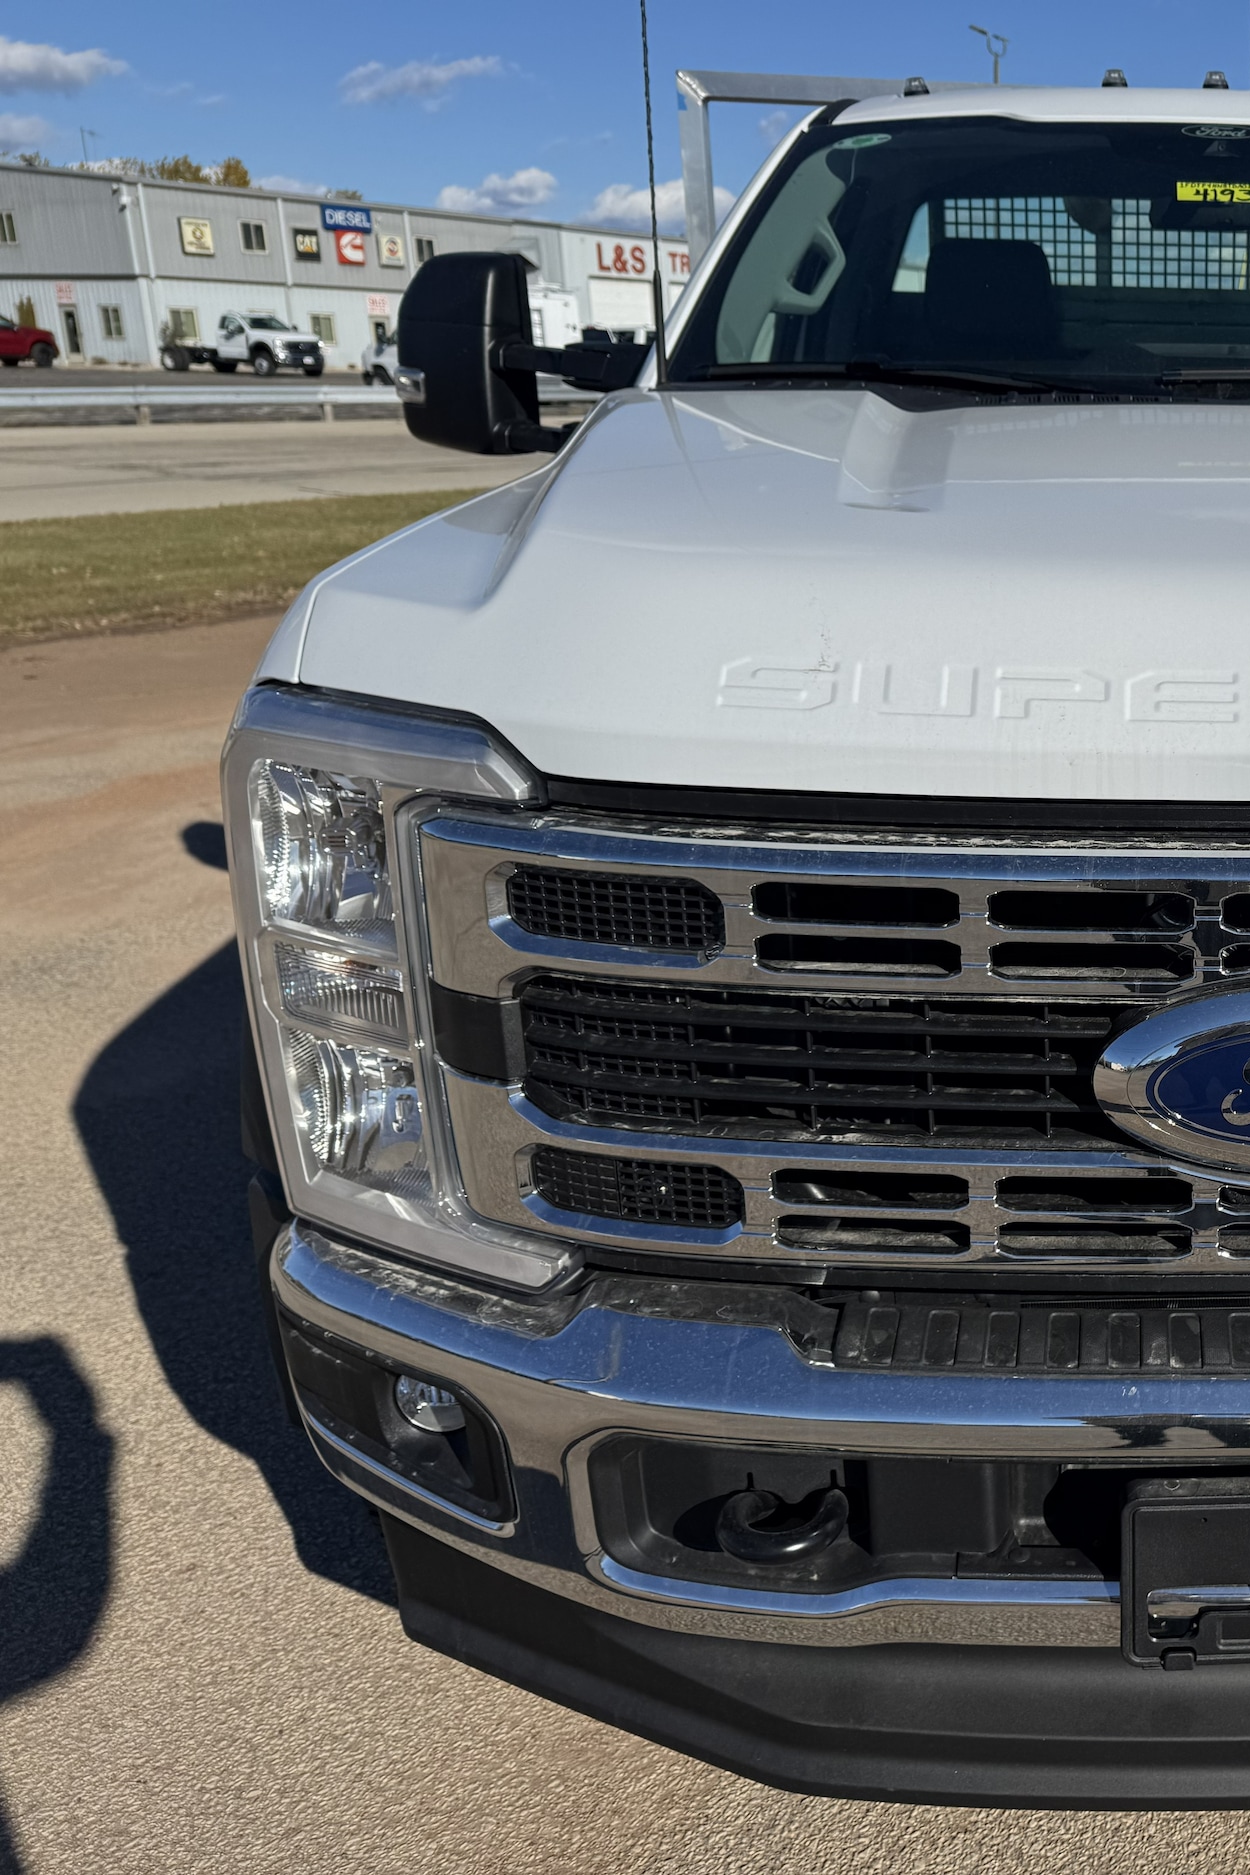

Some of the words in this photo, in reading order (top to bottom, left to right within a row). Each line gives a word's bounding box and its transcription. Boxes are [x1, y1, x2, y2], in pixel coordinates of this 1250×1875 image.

[1196, 126, 1247, 137] Ford
[324, 208, 371, 228] DIESEL
[296, 234, 318, 253] CAT
[596, 242, 646, 274] L&S
